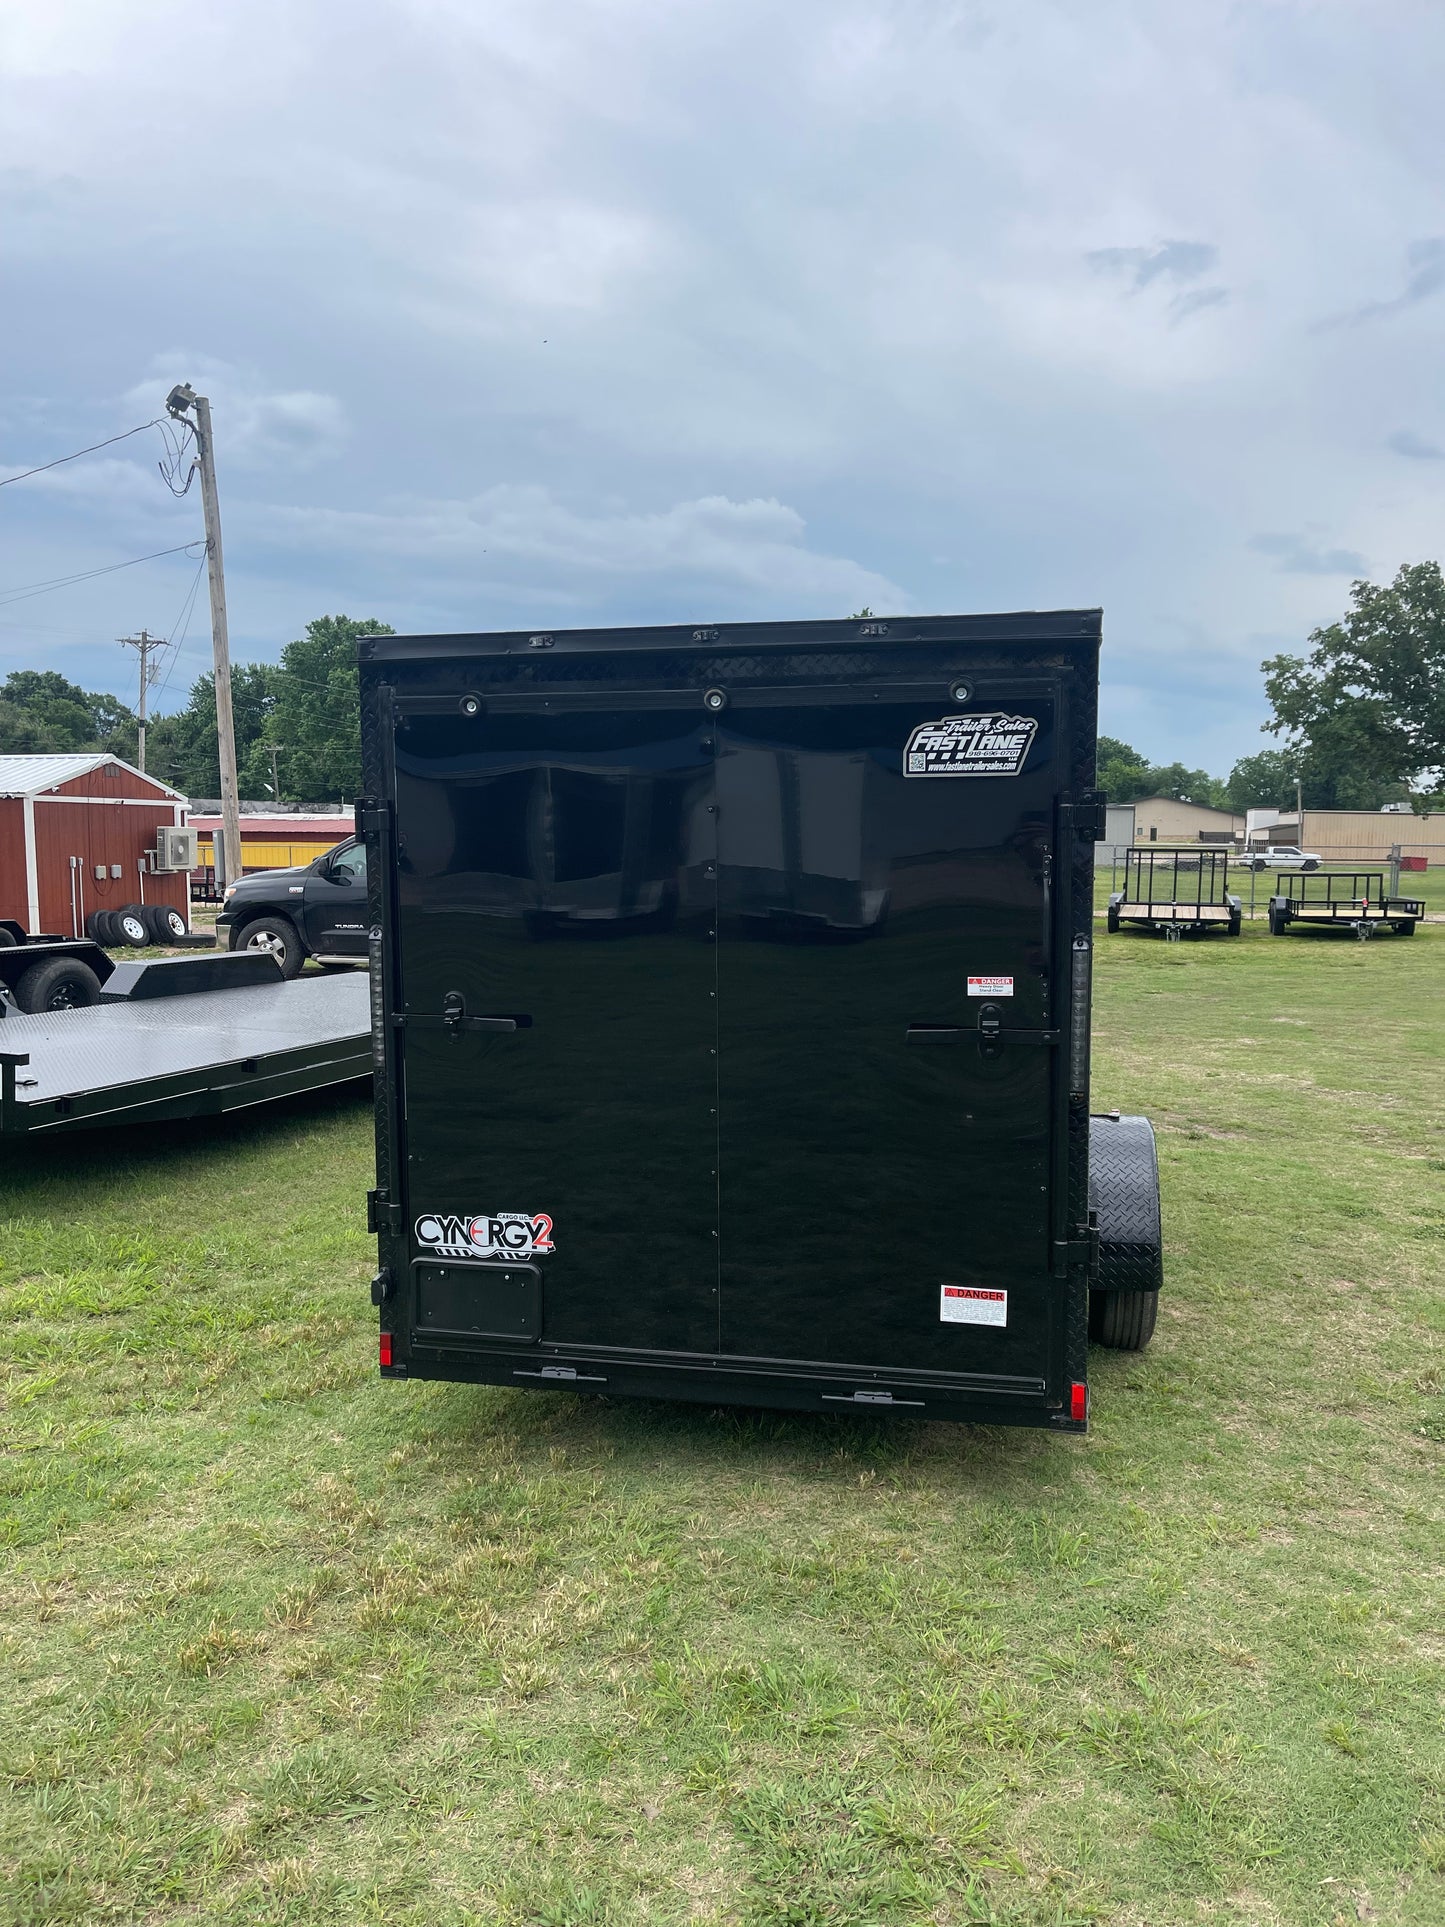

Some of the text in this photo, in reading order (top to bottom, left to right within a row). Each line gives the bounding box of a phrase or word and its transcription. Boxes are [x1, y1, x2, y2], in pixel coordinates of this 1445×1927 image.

[945, 719, 1034, 734] Trailer Sales
[928, 761, 1016, 771] www.fastlanetrailersales.com
[957, 1289, 1005, 1301] DANGER
